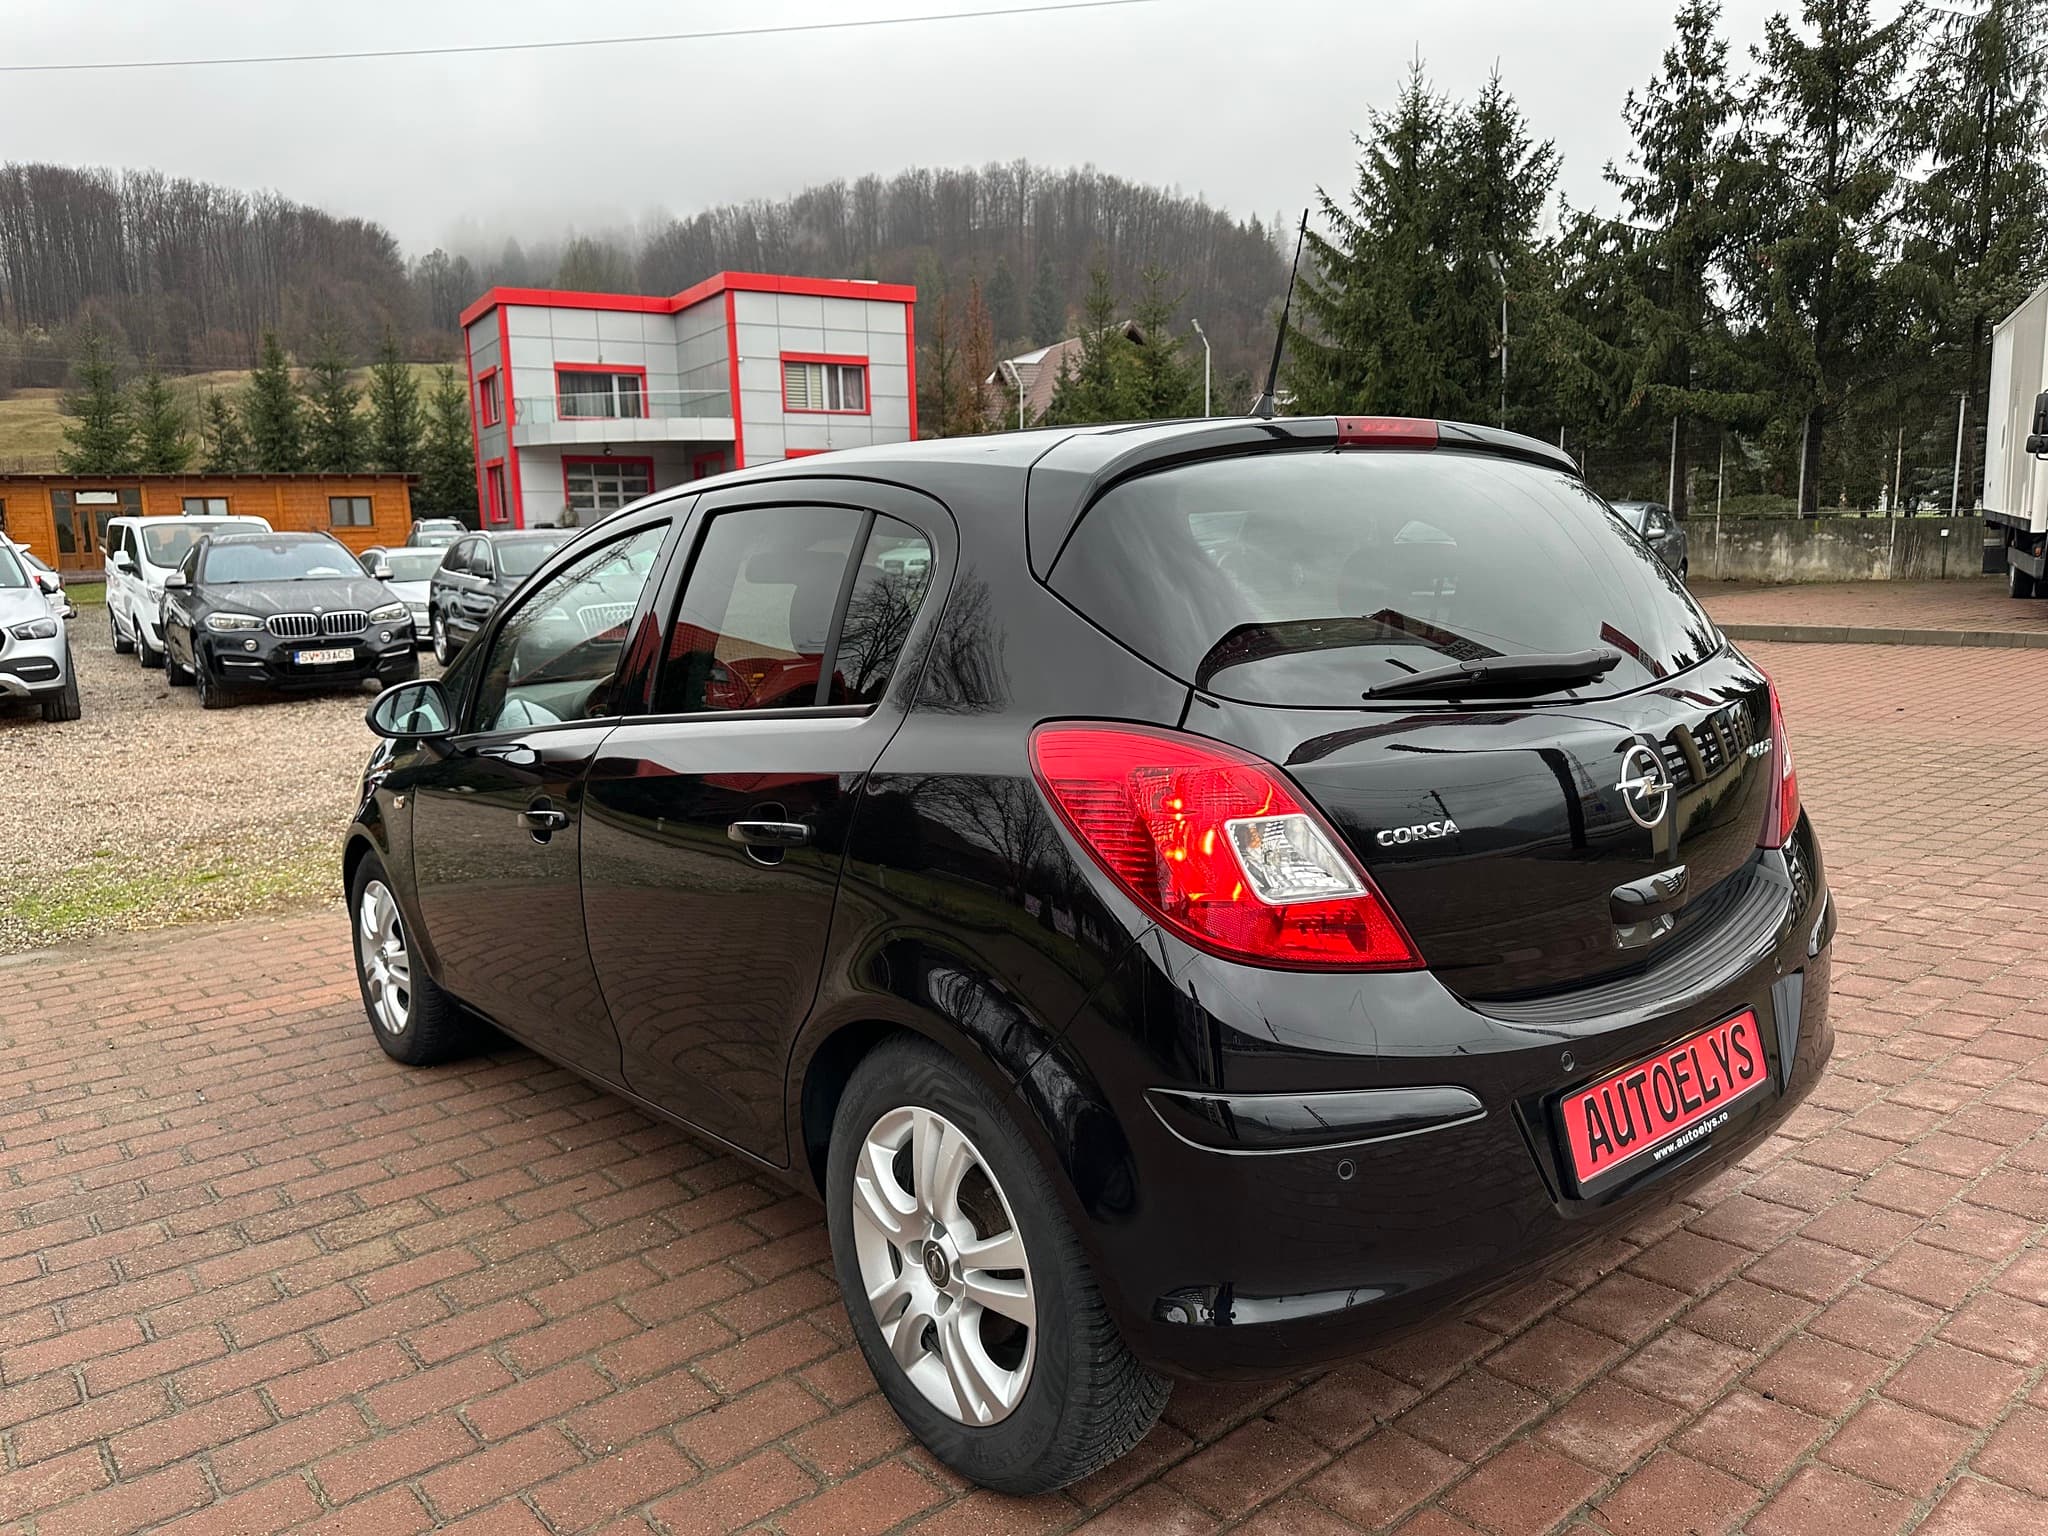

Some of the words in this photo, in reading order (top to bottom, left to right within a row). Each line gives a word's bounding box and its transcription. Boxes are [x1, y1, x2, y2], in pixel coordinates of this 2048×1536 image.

[1376, 819, 1460, 847] CORSA
[1584, 1024, 1754, 1162] AUTOELYS
[1653, 1111, 1728, 1161] www.autoelys.ro
